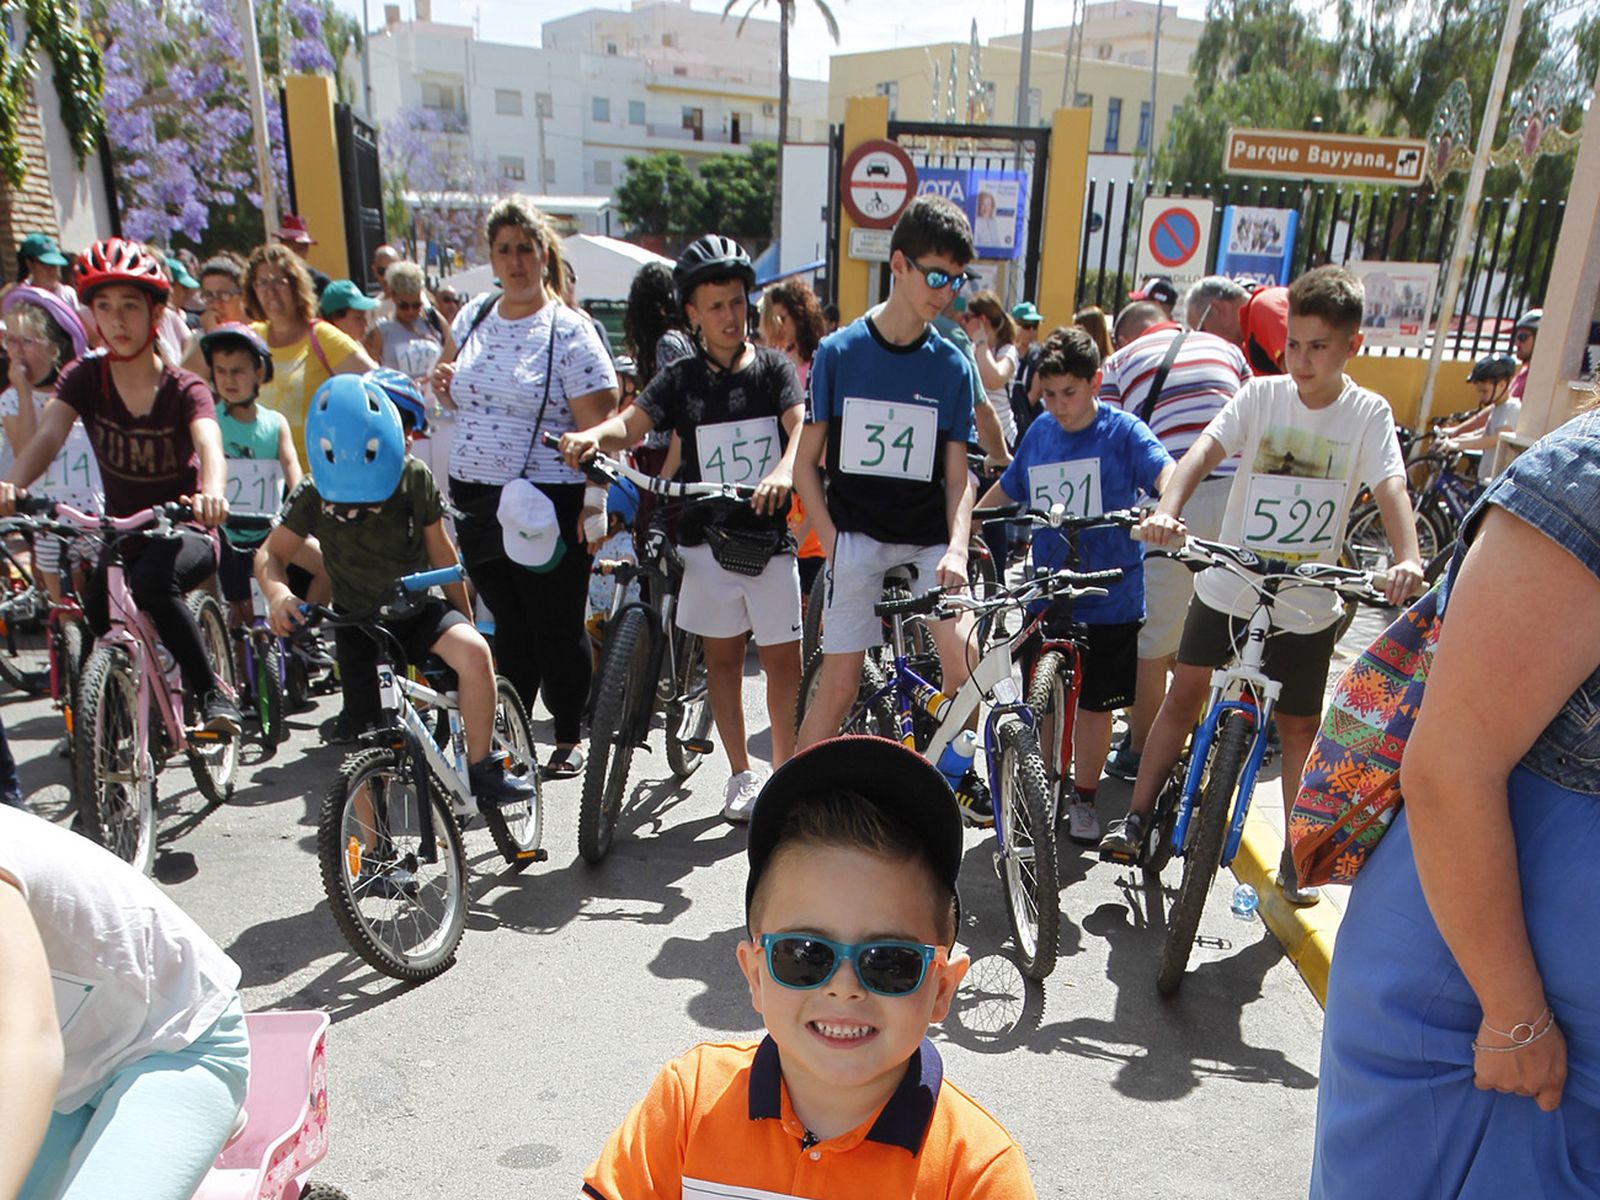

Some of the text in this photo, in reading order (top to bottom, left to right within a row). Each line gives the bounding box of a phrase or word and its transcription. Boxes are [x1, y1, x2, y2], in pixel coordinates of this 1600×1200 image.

[1233, 140, 1299, 163] Parque
[704, 435, 772, 483] 457
[860, 424, 915, 472] 34
[1035, 473, 1092, 517] 521
[1246, 498, 1337, 544] 522
